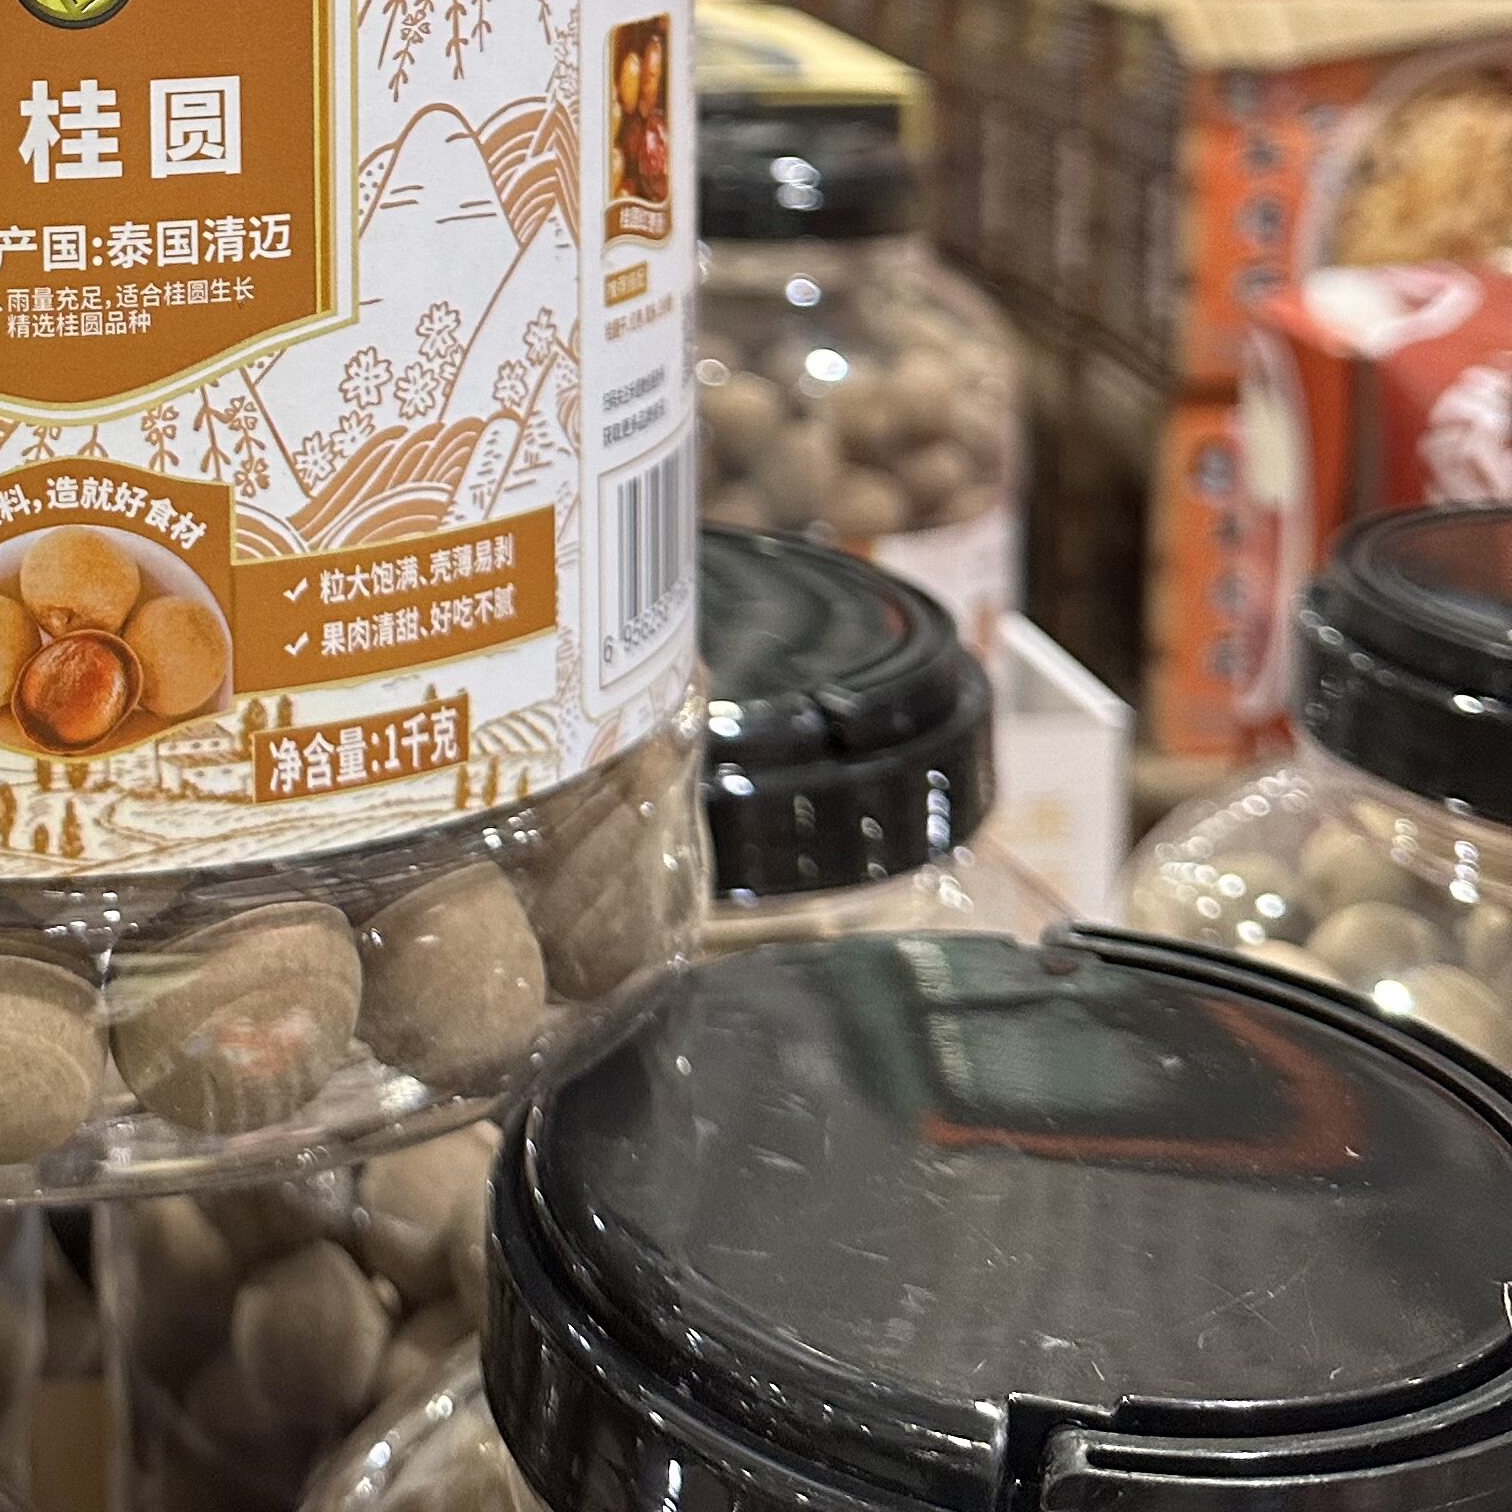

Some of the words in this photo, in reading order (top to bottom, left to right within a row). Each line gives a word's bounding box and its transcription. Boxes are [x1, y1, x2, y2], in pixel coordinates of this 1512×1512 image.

[7, 312, 152, 339] 精选桂圆品种
[319, 532, 516, 605] 粒大饱满、壳薄易剥
[320, 583, 516, 656] 果肉清甜、好吃不腻
[269, 706, 459, 794] 净含量:1千克
